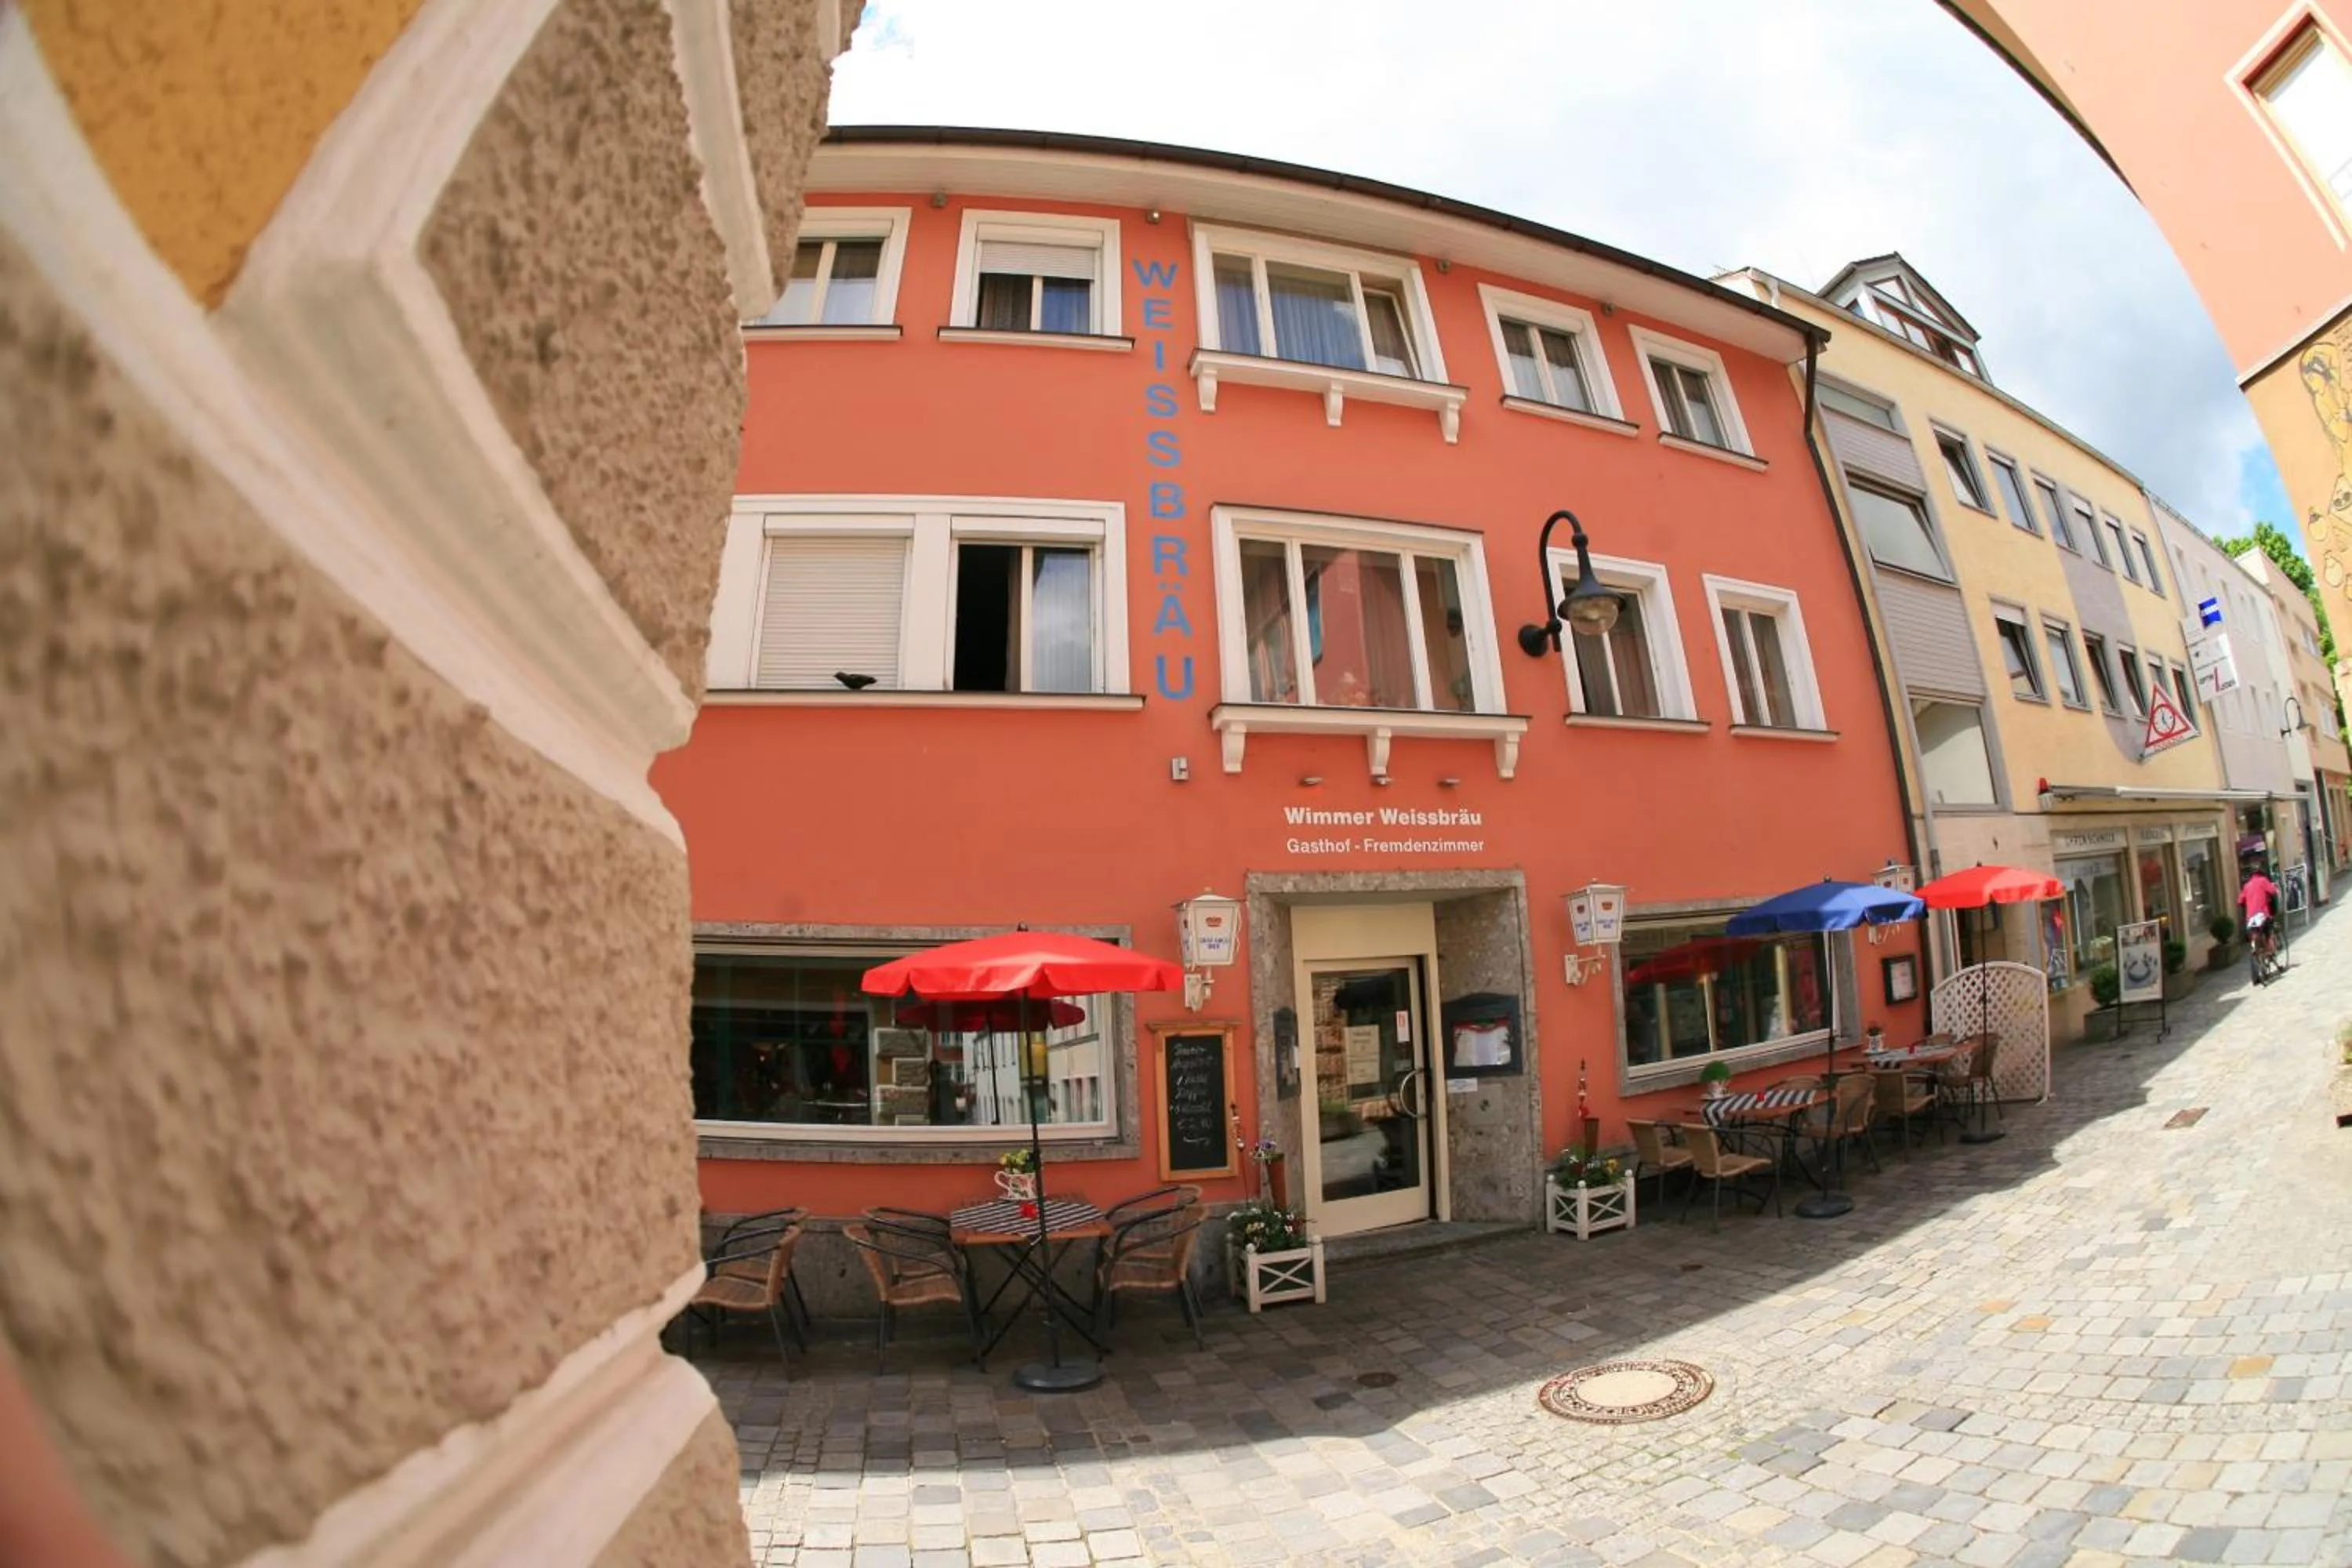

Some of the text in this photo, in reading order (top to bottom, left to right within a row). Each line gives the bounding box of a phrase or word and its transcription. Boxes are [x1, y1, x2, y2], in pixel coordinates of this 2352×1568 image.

[1131, 259, 1194, 700] WEISSBRÄU
[1283, 807, 1482, 826] Wimmer Weissbräu
[1287, 838, 1352, 853] Gasthof
[1363, 837, 1485, 853] Fremdenzimmer
